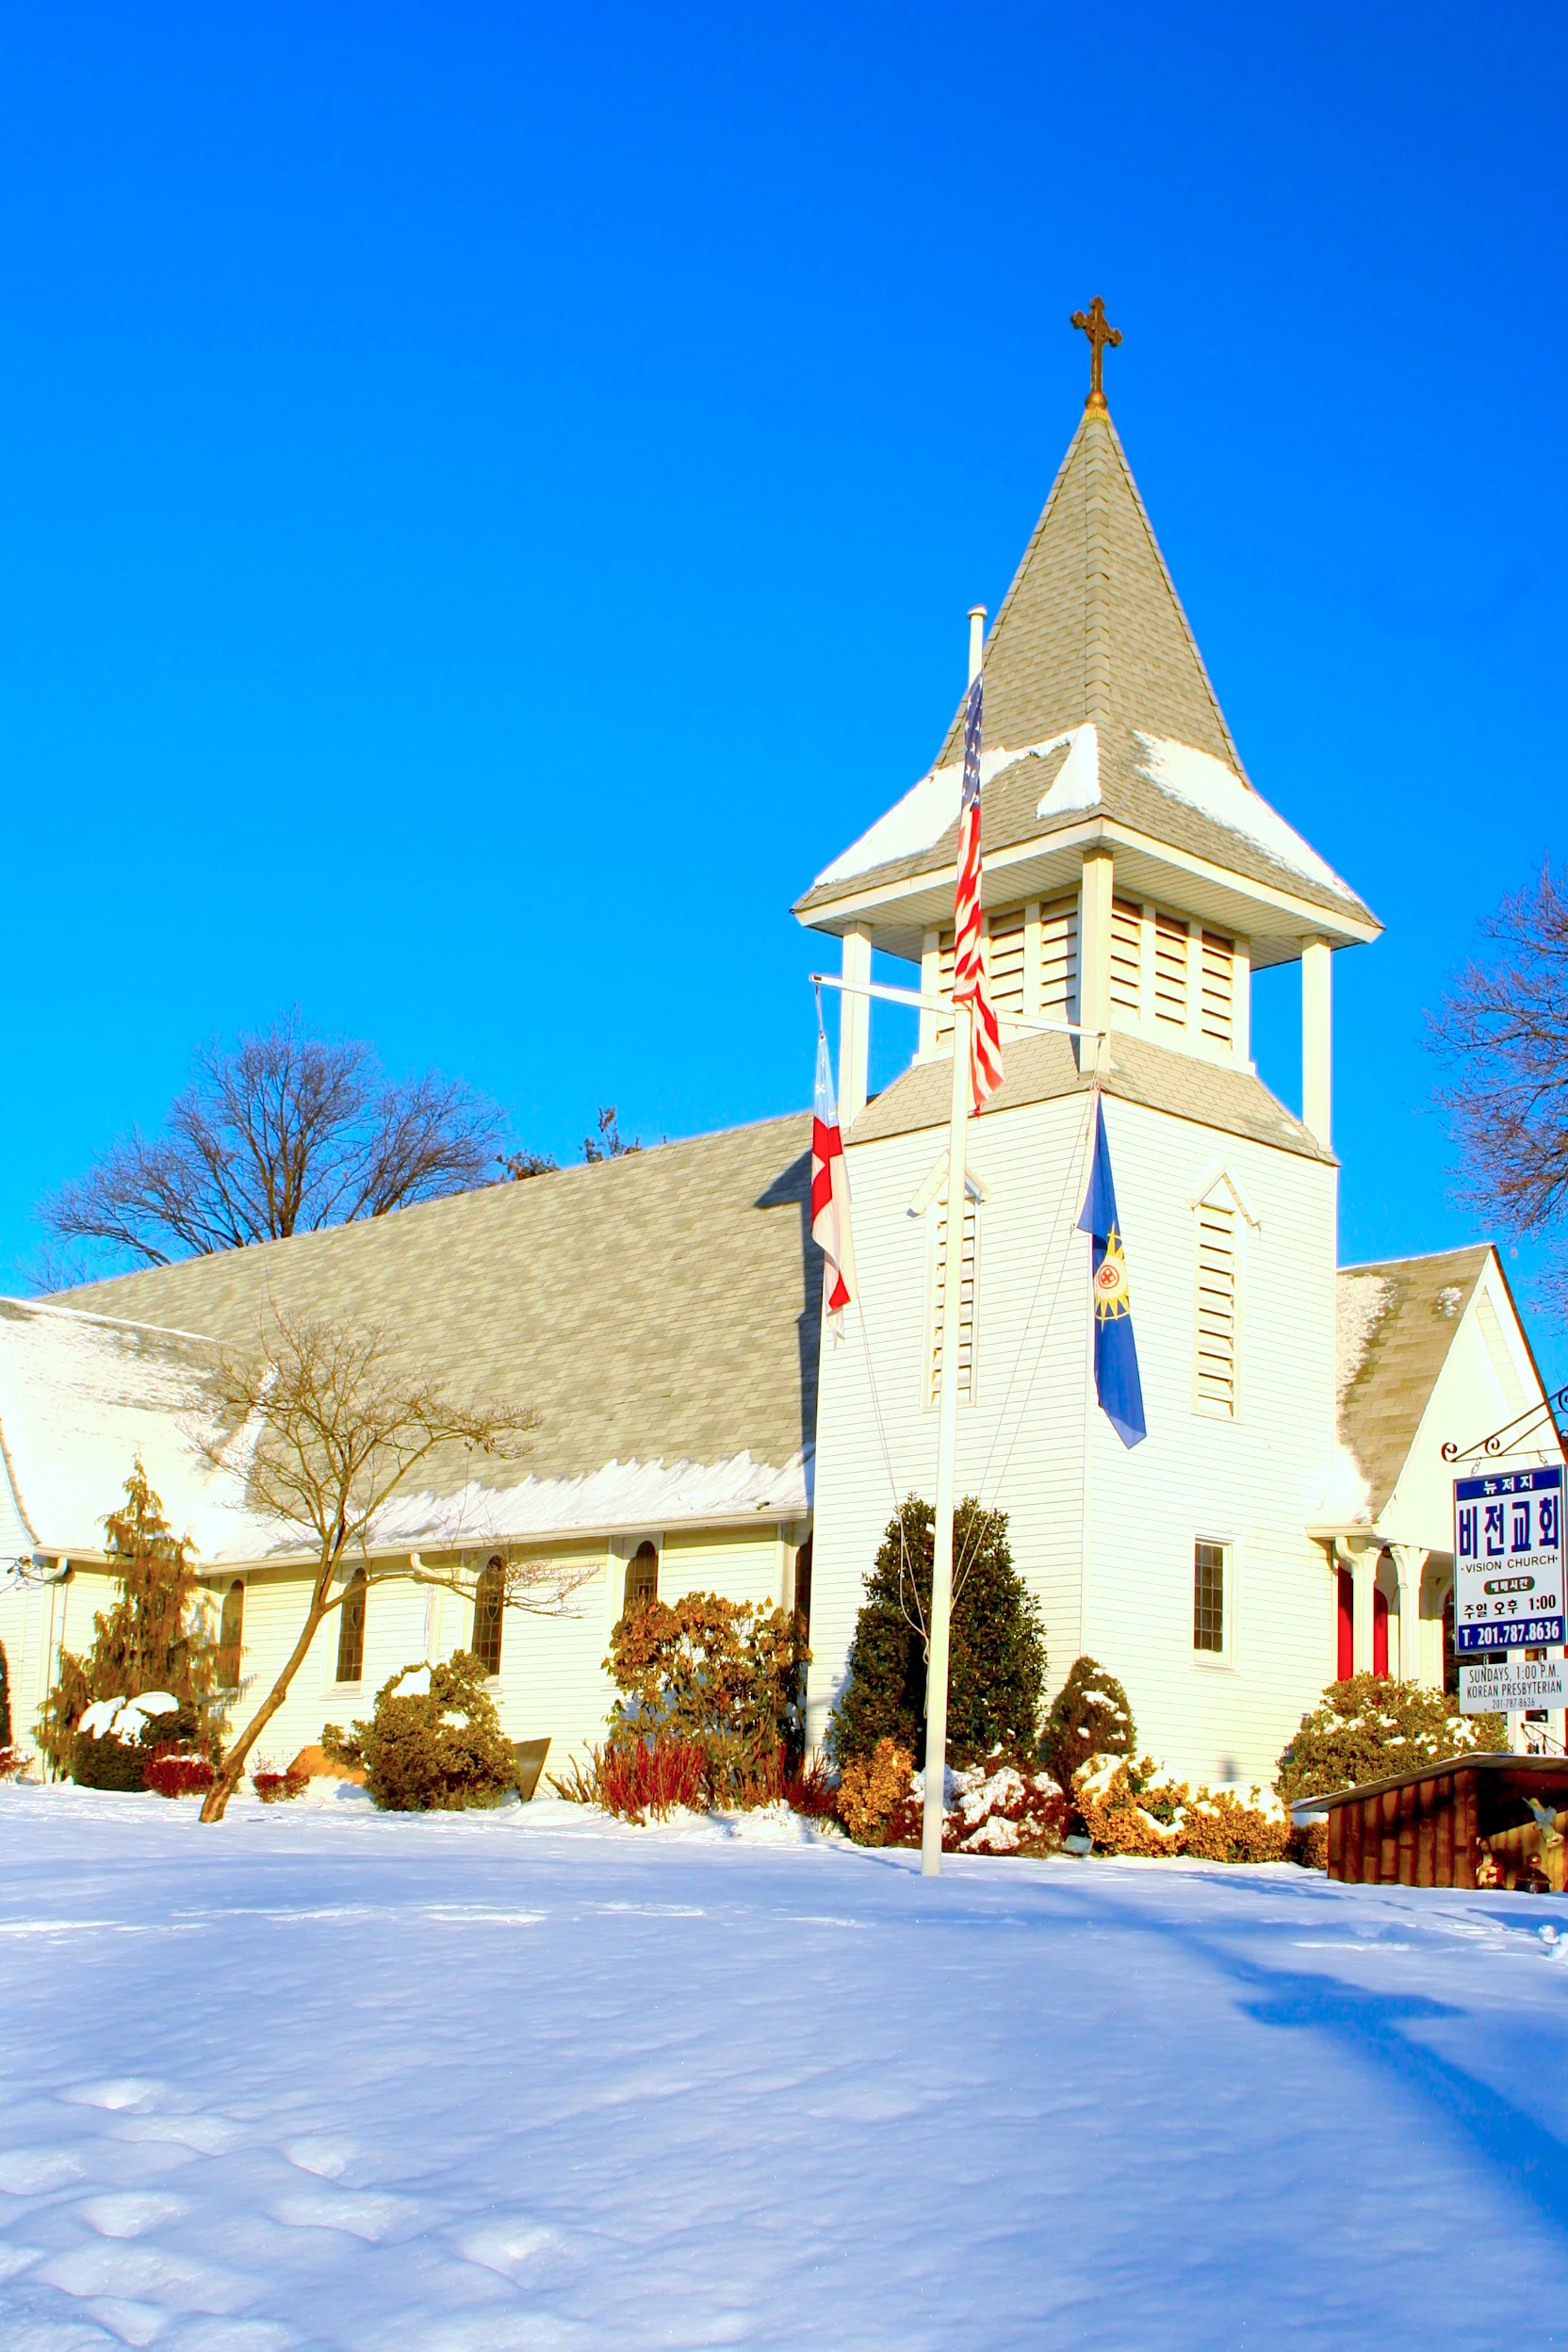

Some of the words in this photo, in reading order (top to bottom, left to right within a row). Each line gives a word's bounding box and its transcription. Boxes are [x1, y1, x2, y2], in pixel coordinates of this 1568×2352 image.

[1483, 1474, 1533, 1494] 뉴저지
[1460, 1494, 1559, 1560] 비전교회
[1463, 1603, 1487, 1619] 주일
[1494, 1599, 1518, 1616] 오후
[1528, 1594, 1556, 1611] 1:00
[1462, 1629, 1473, 1646] T.
[1478, 1621, 1560, 1645] 201.787.8636
[1469, 1667, 1511, 1683] SUNDAYS,
[1516, 1665, 1536, 1679] 1:00
[1540, 1663, 1560, 1678] P.M.
[1467, 1684, 1498, 1698] KOREAN
[1502, 1680, 1561, 1696] PRESBYTERIAN
[1493, 1697, 1535, 1709] 201-787-8636
